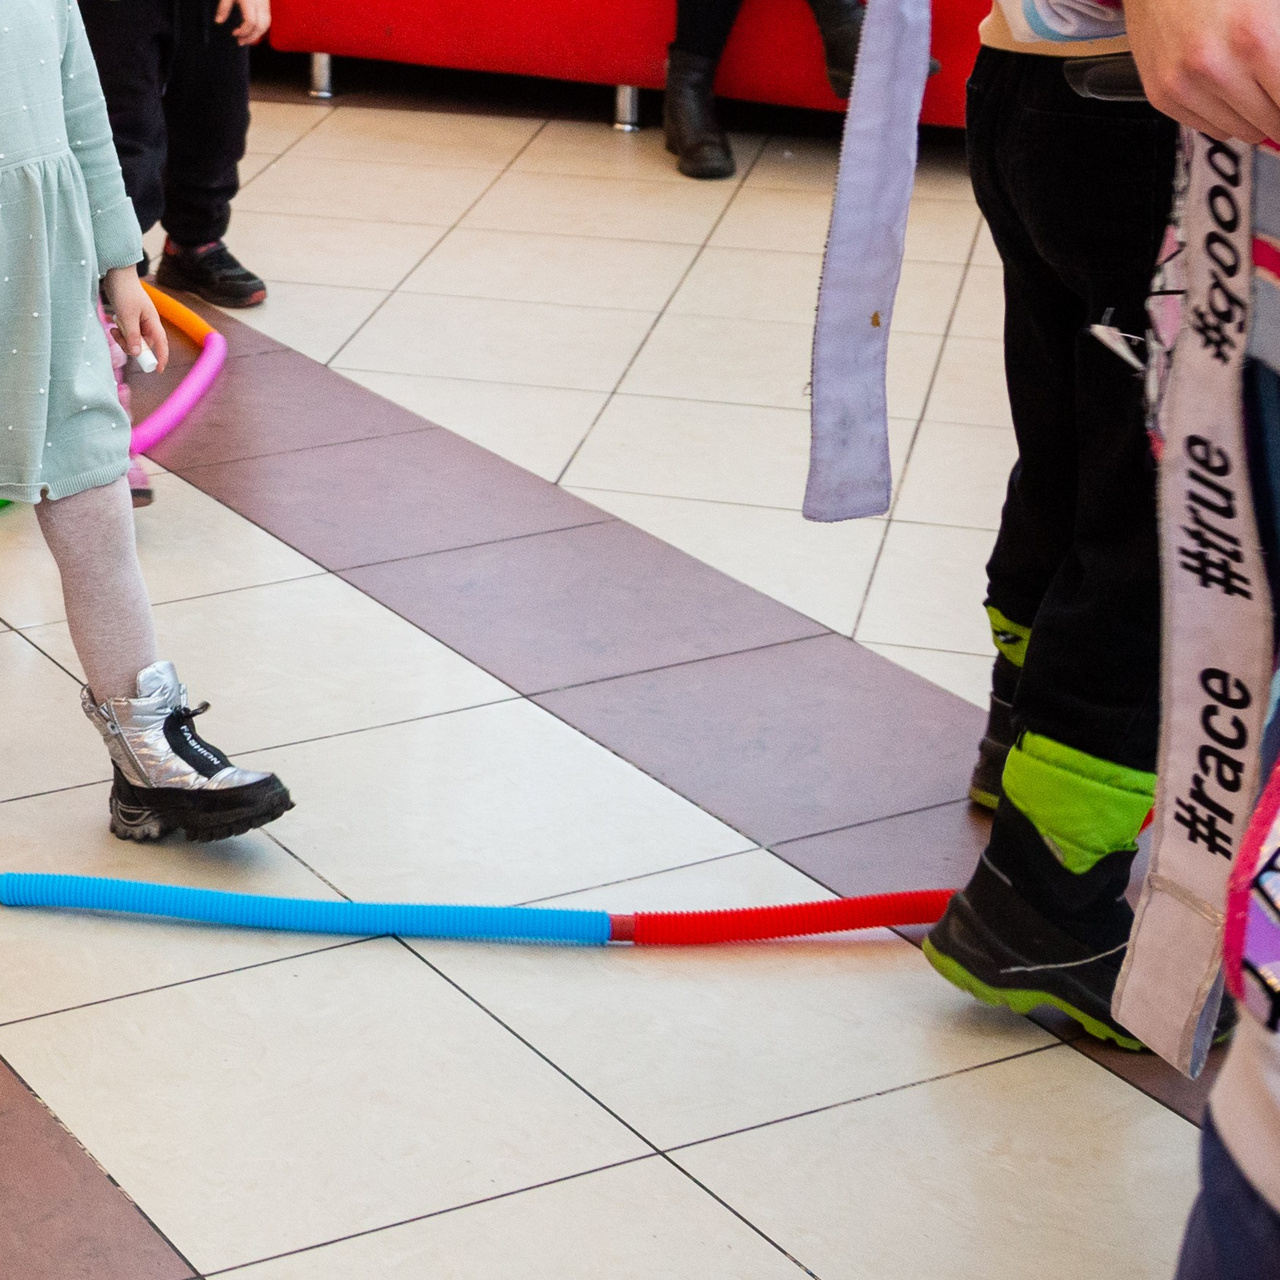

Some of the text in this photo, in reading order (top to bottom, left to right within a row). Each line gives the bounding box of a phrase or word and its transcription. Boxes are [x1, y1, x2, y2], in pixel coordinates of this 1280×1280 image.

[1175, 131, 1253, 861] #race #true #good
[180, 724, 221, 765] FASHION
